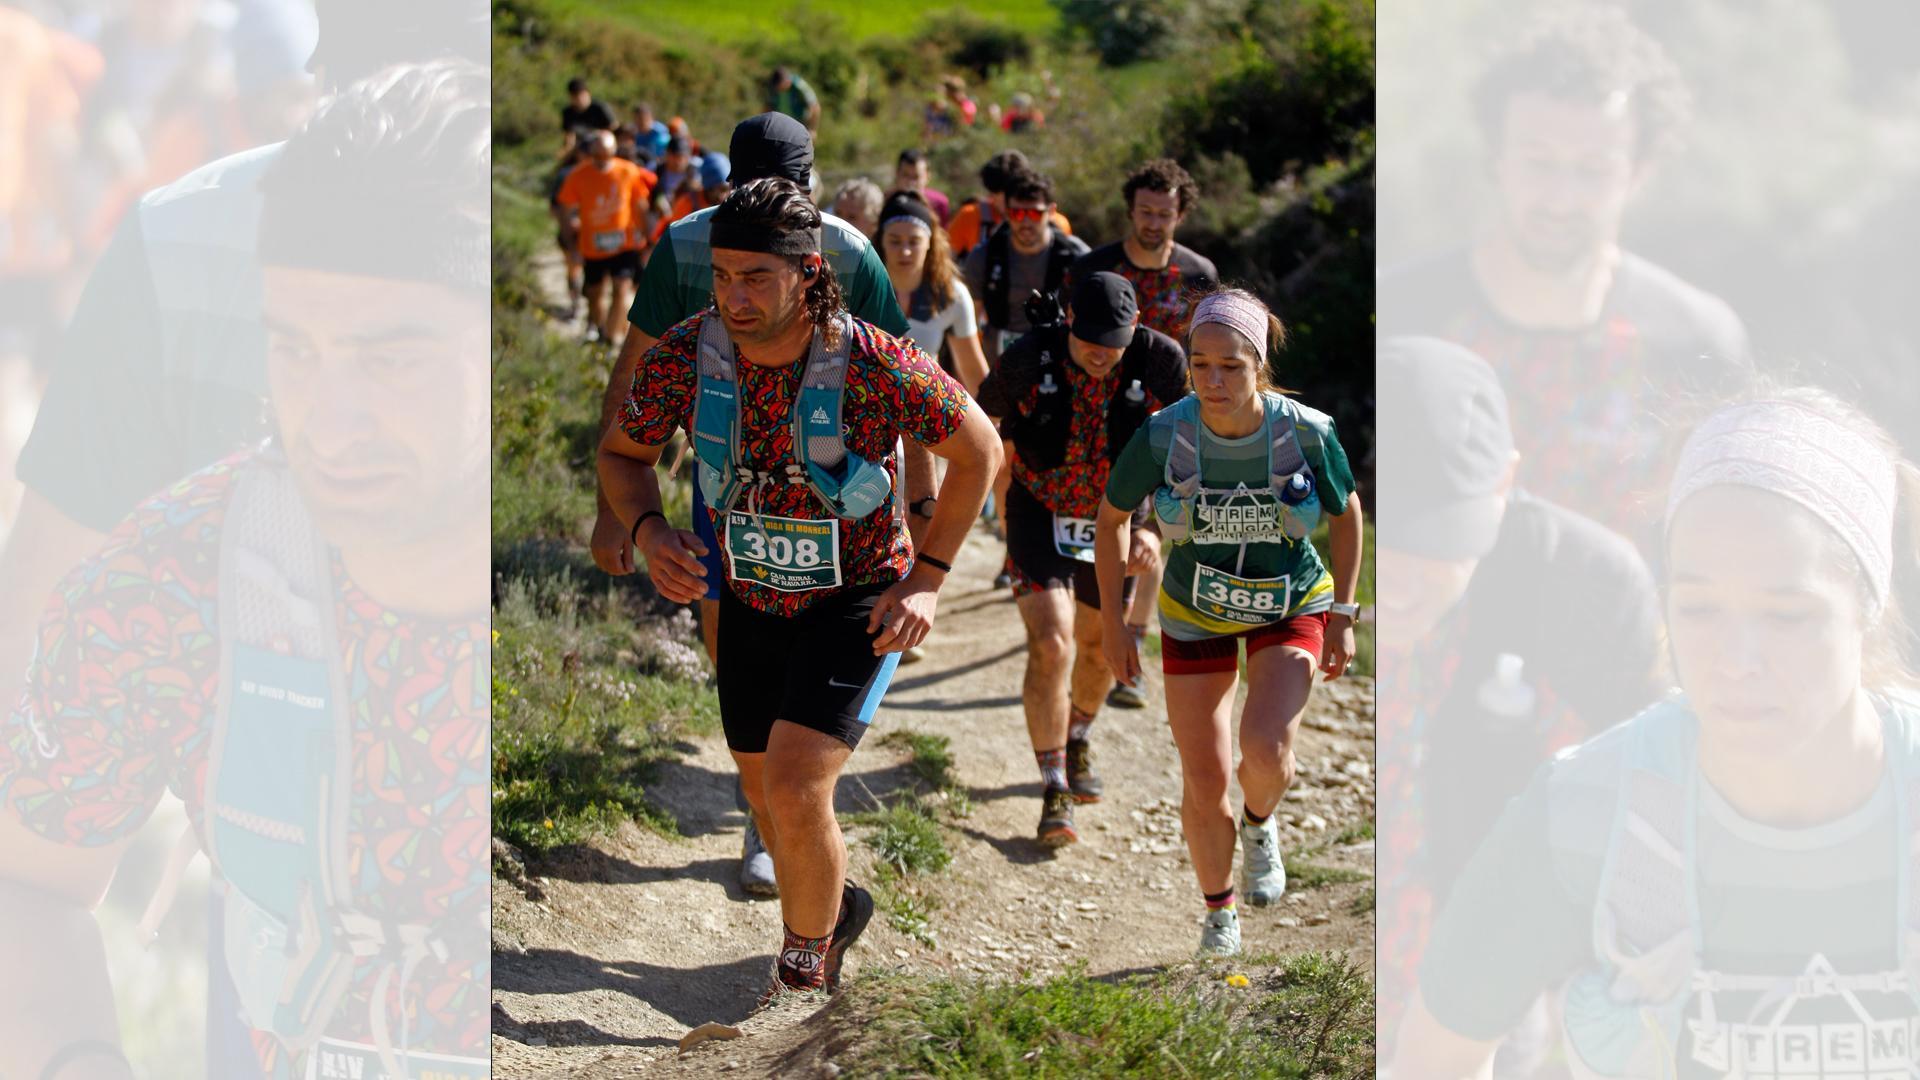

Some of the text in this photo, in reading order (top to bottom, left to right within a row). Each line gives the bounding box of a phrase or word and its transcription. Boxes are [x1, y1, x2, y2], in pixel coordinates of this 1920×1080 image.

[743, 532, 820, 567] 308
[781, 579, 818, 587] NAVARRA
[1208, 582, 1274, 610] 368
